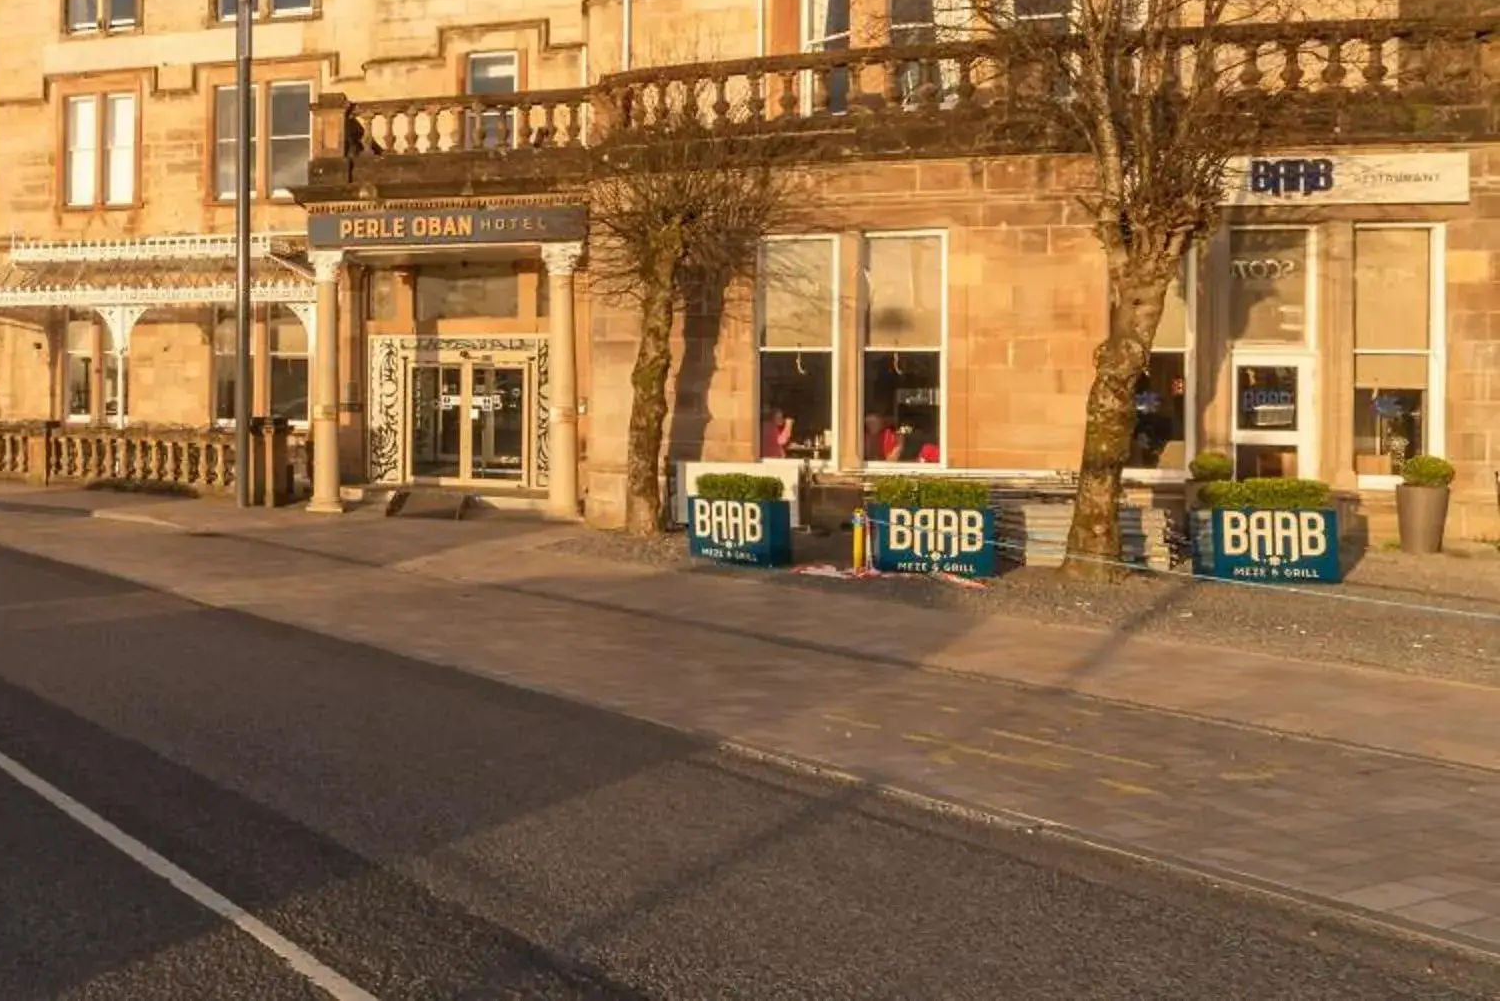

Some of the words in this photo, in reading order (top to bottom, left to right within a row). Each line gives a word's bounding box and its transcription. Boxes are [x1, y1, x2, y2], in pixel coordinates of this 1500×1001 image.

[1251, 159, 1333, 196] BAAB
[339, 216, 405, 239] PERLE
[411, 214, 474, 237] OBAN
[480, 217, 547, 231] HOTEL
[694, 499, 763, 546] BAAB
[889, 508, 983, 557] BAAB
[1222, 510, 1327, 562] BAAB
[897, 562, 928, 572] MEZE
[943, 562, 977, 572] GRILL
[1234, 567, 1266, 577] MEZE
[1283, 568, 1320, 578] GRILL
